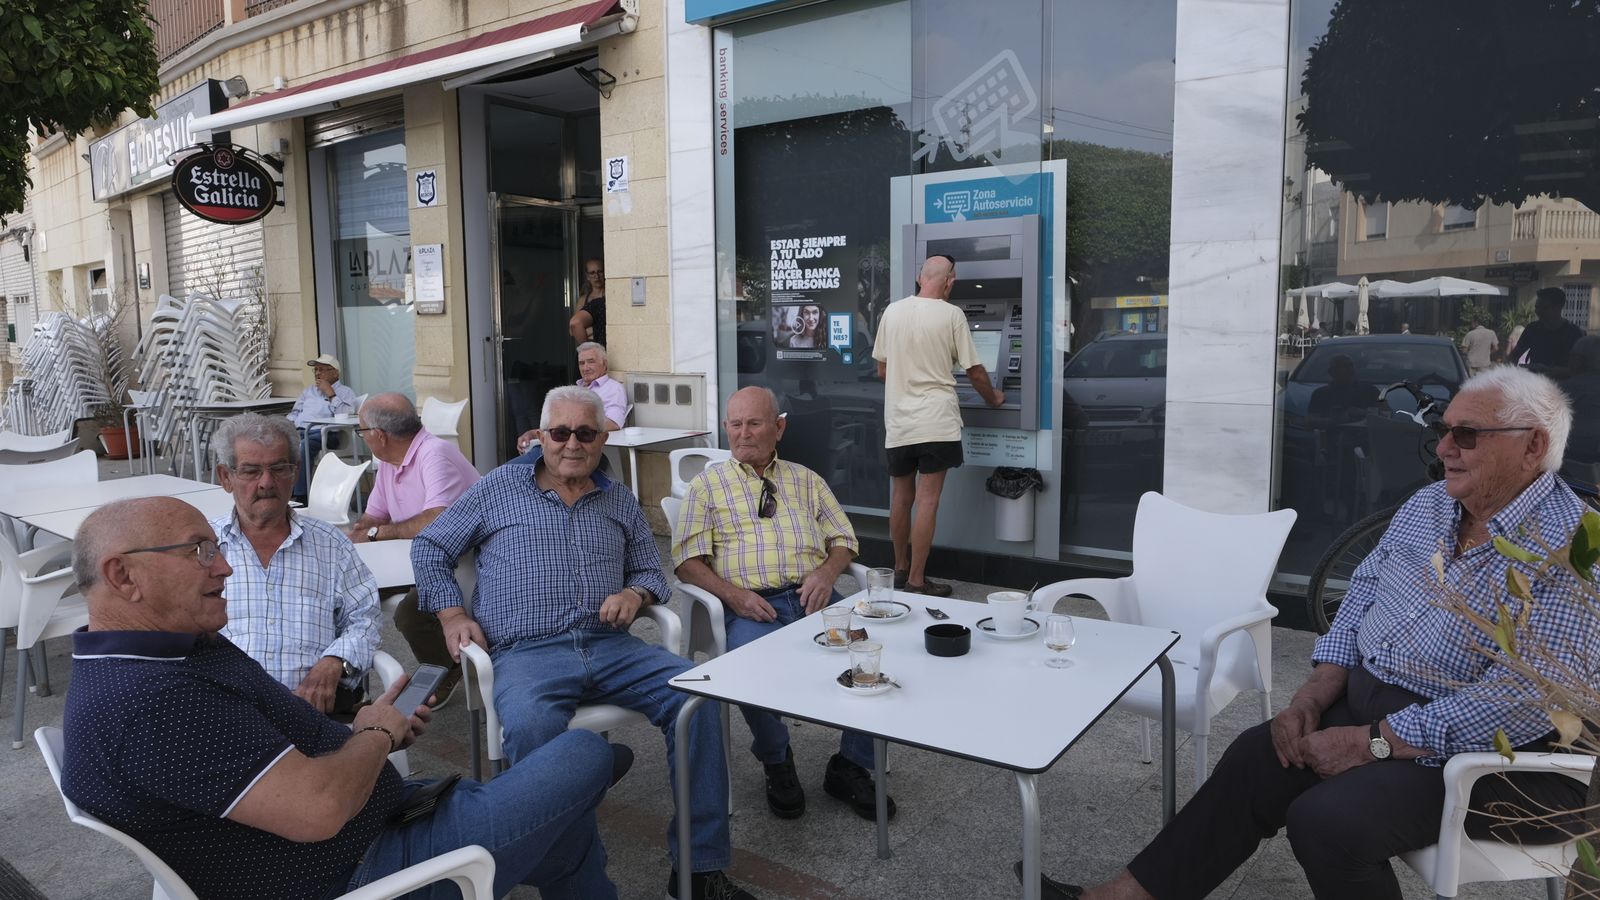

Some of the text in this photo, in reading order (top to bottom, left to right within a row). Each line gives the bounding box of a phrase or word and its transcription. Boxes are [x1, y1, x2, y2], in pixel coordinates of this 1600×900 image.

[718, 48, 730, 156] banking services
[189, 165, 262, 190] Estrella
[194, 184, 260, 207] Galicia
[972, 189, 996, 200] Zona
[972, 196, 1034, 211] Autoservicio
[770, 235, 847, 250] ESTAR SIEMPRE
[771, 247, 824, 260] A TU LADO
[771, 259, 799, 270] PARA
[771, 267, 841, 280] HACER BANCA
[771, 278, 840, 290] DE PERSONAS
